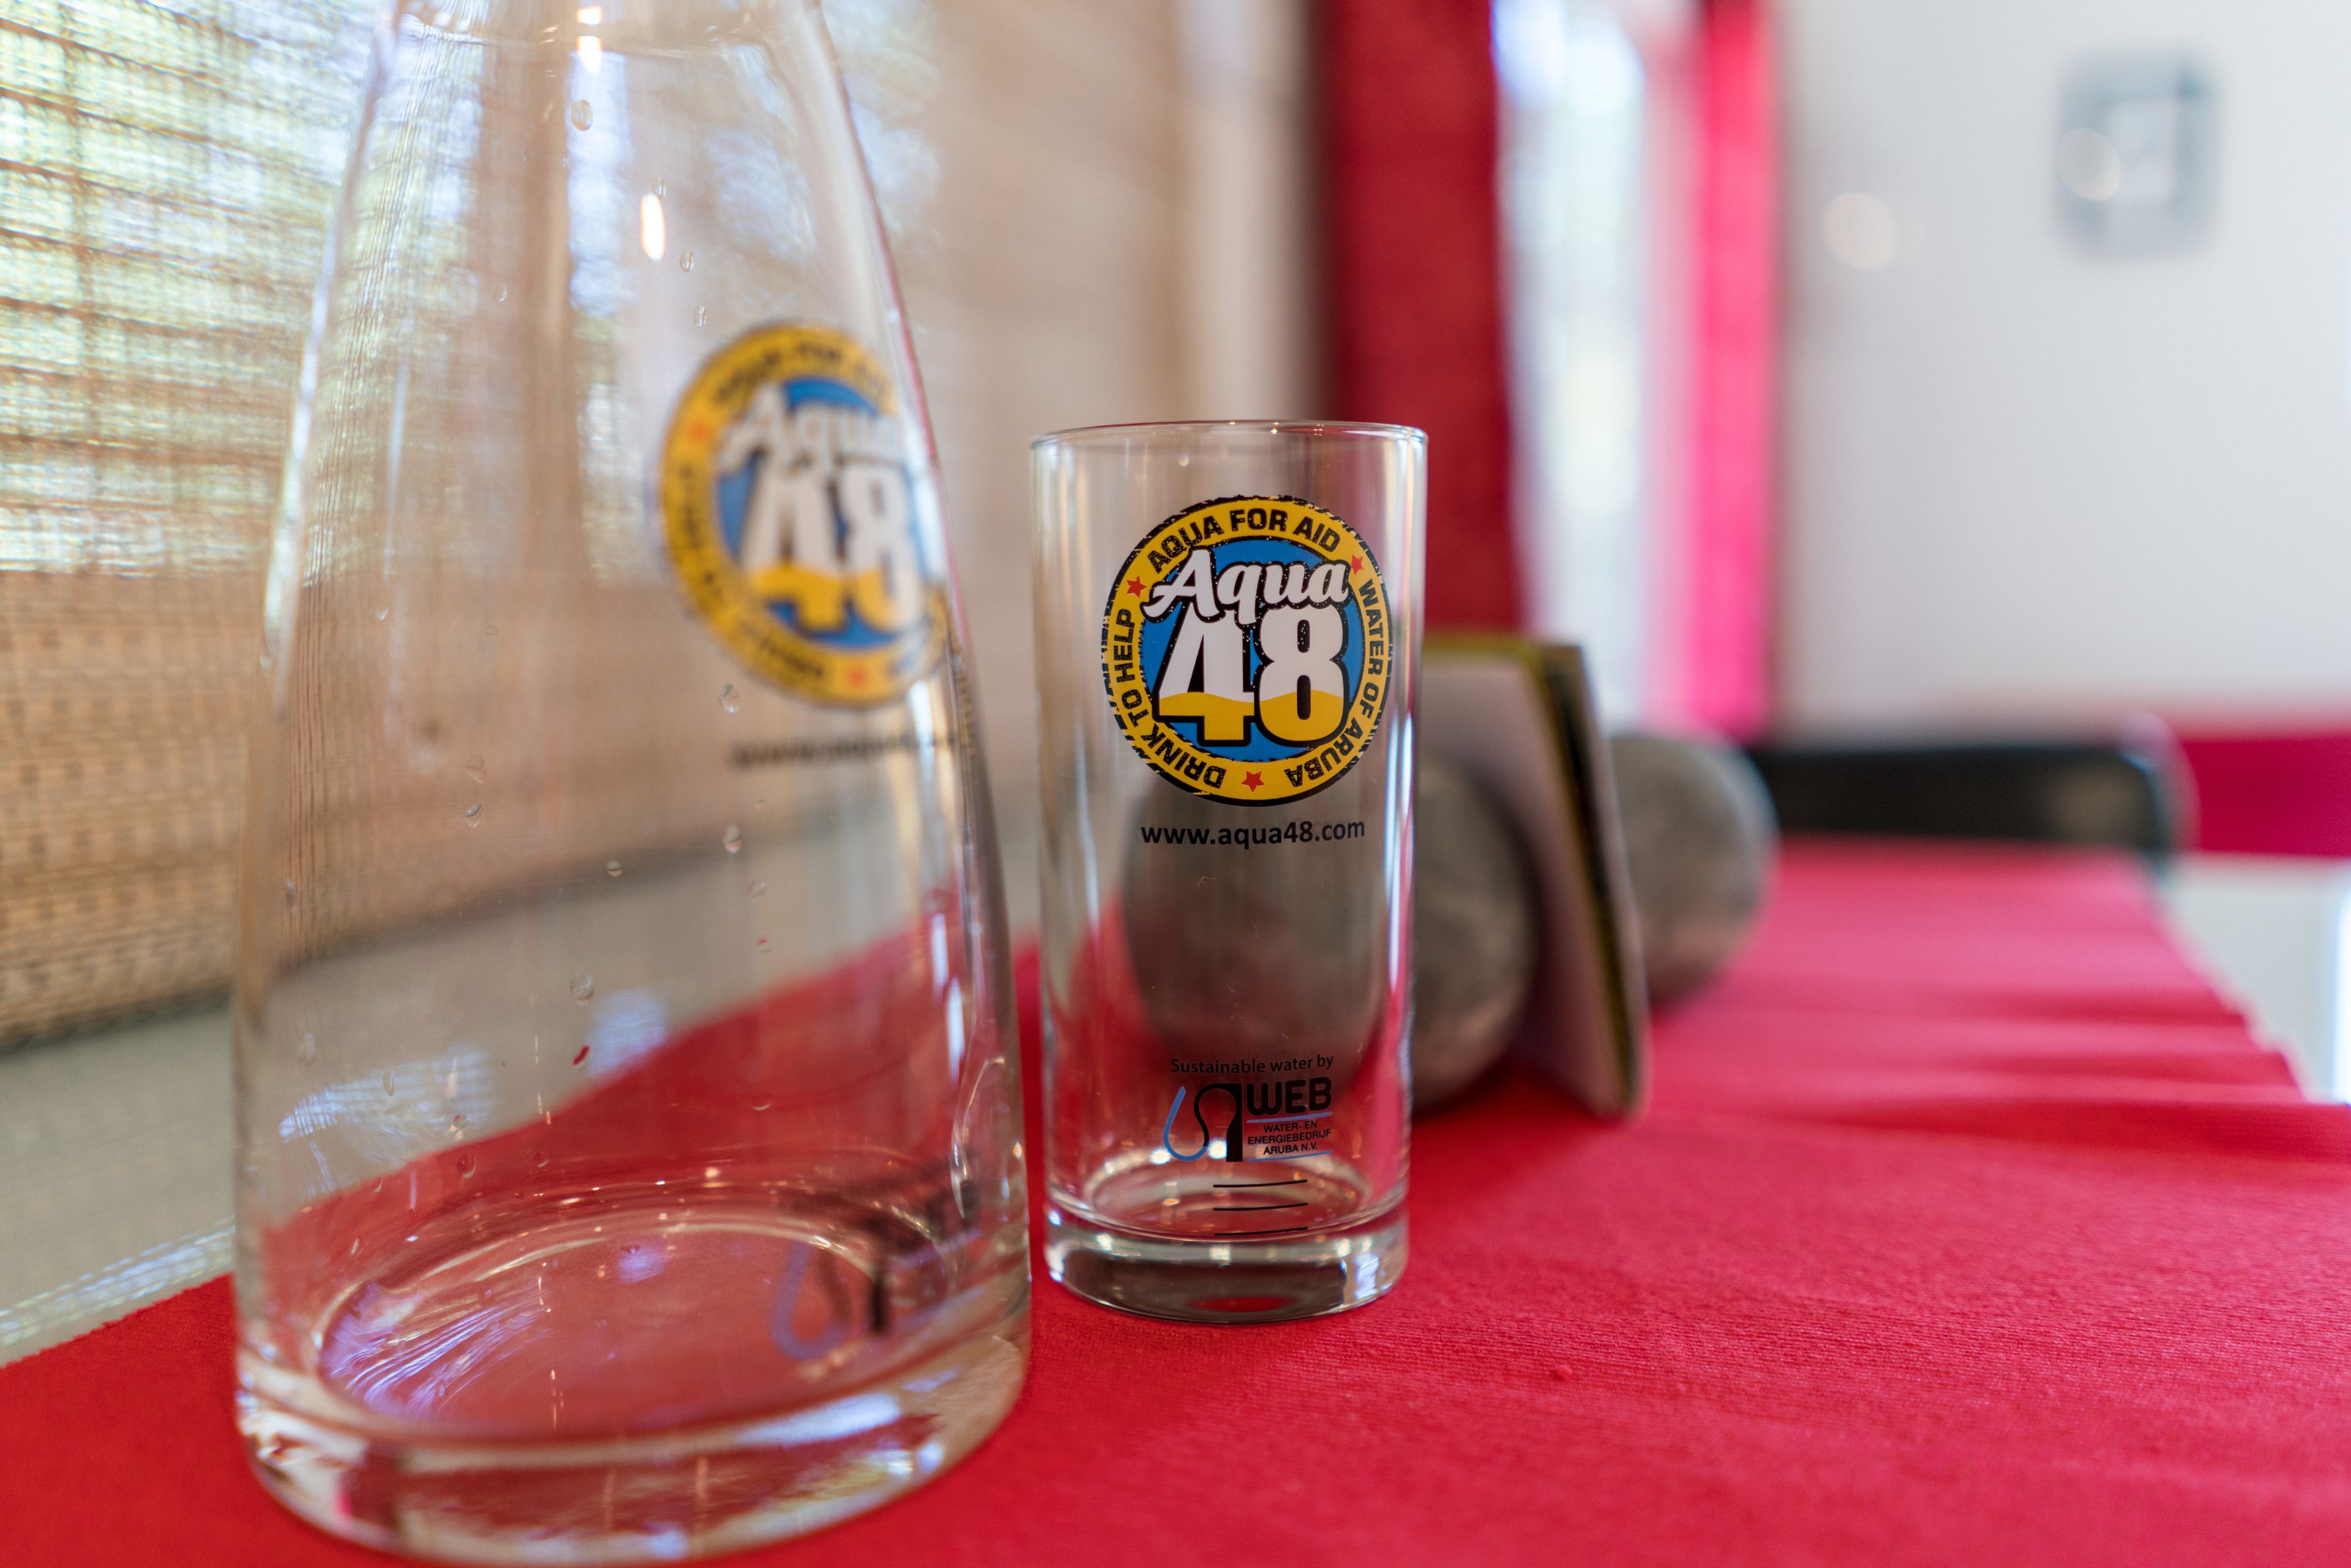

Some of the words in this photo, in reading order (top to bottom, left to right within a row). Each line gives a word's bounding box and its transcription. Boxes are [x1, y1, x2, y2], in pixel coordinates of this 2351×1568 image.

[1147, 516, 1224, 574] AQUA
[1229, 508, 1288, 531] FOR
[1292, 516, 1341, 552] AID
[1141, 549, 1348, 625] Aqua
[1114, 609, 1135, 683] HELP
[1359, 579, 1384, 676] WATER
[1158, 602, 1344, 741] 48
[1121, 689, 1149, 727] TO
[1360, 681, 1379, 719] OF
[1141, 723, 1227, 789] DRINK
[1284, 717, 1364, 787] ARUBA
[1141, 821, 1365, 850] www.aqua48.com
[1171, 1059, 1265, 1073] Sustainable
[1270, 1057, 1313, 1071] water
[1317, 1054, 1334, 1069] by
[1247, 1076, 1332, 1116] WEB
[1247, 1128, 1332, 1145] ENERGIEBEDRIJF
[1263, 1122, 1302, 1133] WATER-
[1305, 1120, 1318, 1130] EN
[1263, 1145, 1299, 1155] ARUBA
[1301, 1142, 1318, 1152] N.V.
